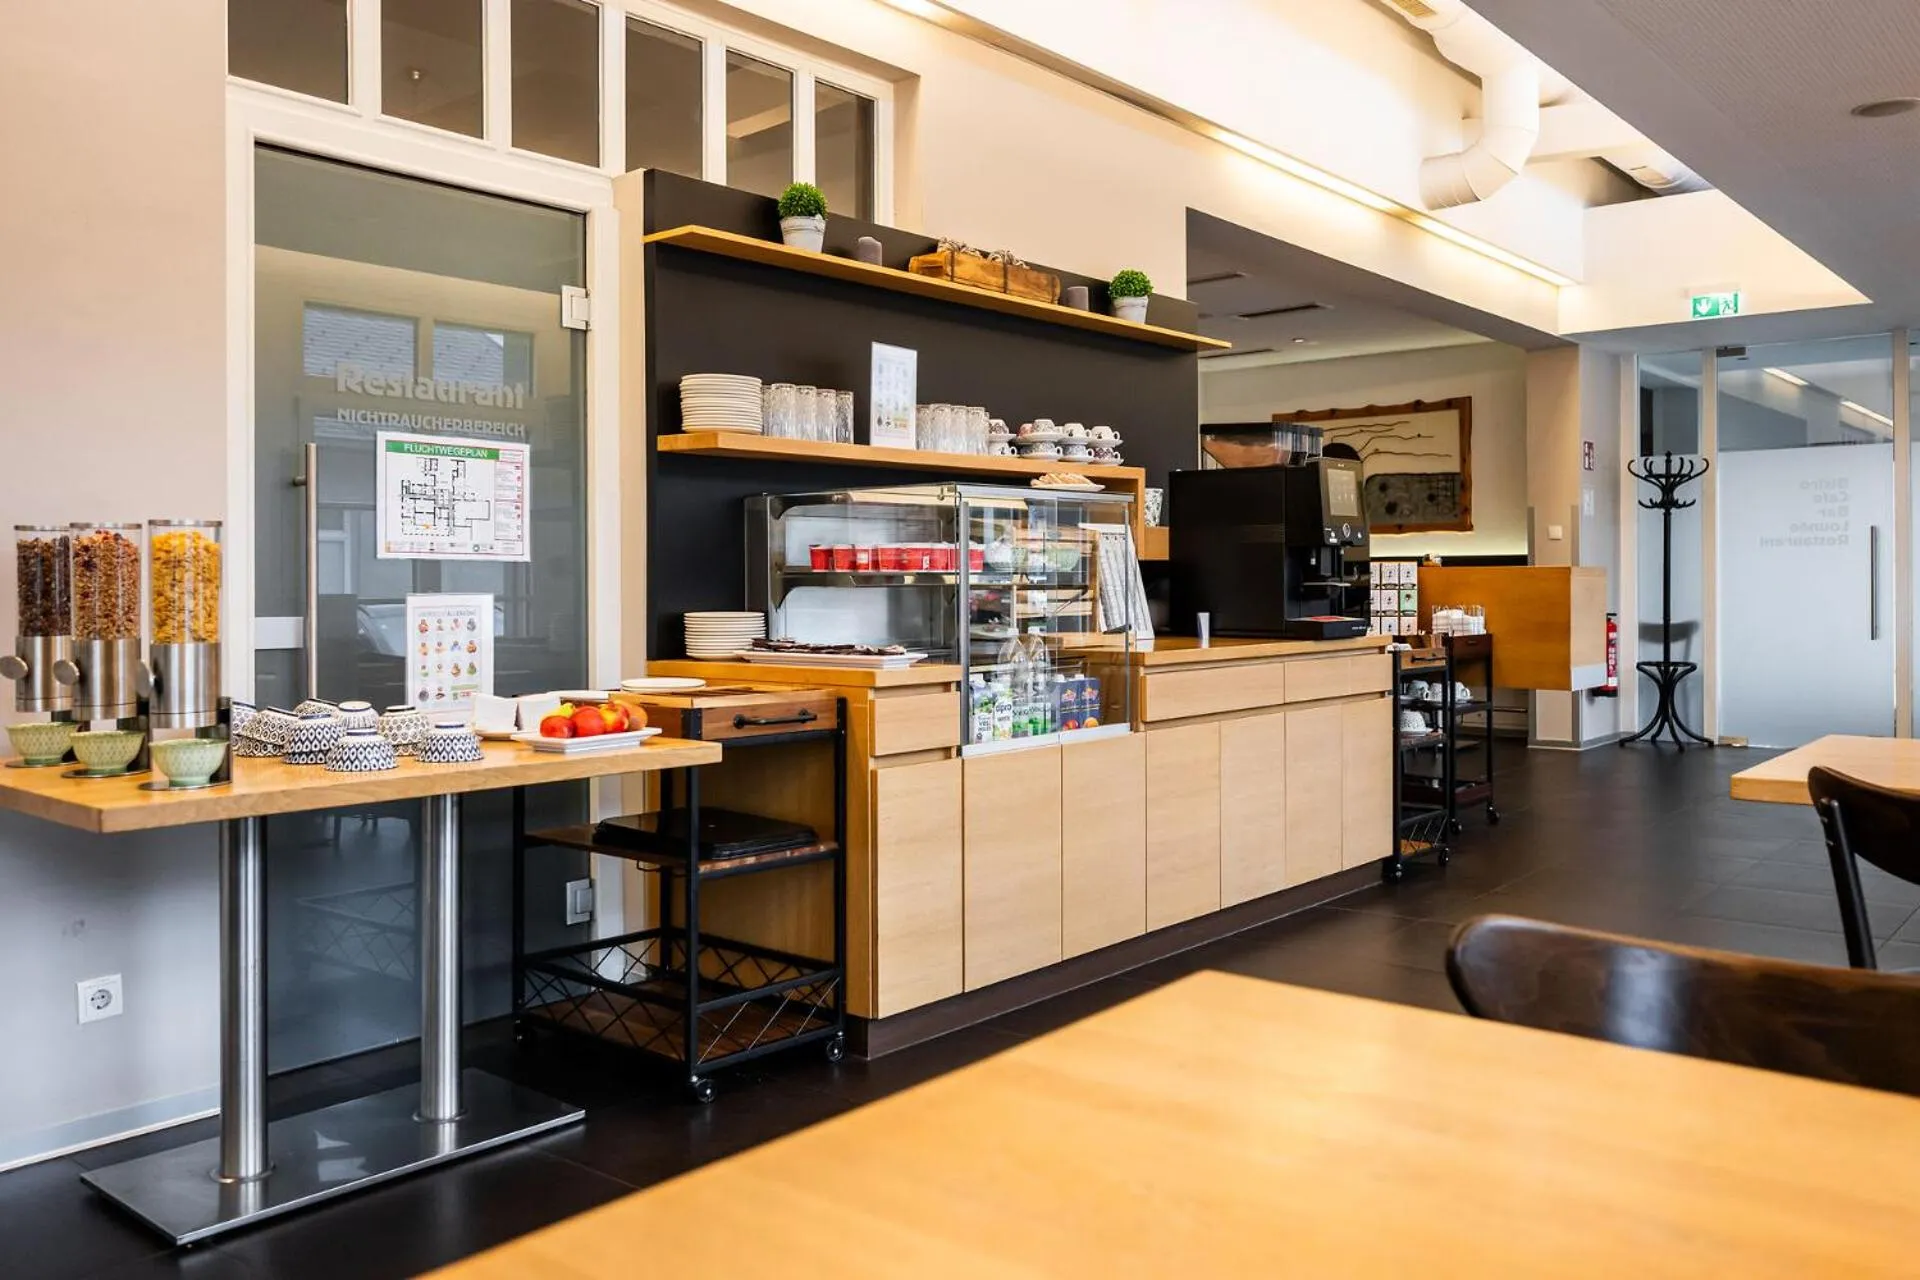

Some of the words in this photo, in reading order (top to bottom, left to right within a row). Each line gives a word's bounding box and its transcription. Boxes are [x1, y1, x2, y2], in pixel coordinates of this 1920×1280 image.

[336, 362, 524, 409] Restaurant
[337, 408, 525, 437] NICHTRAUCHERBEREICH
[403, 443, 488, 458] FLUCHTWEGEPLAN
